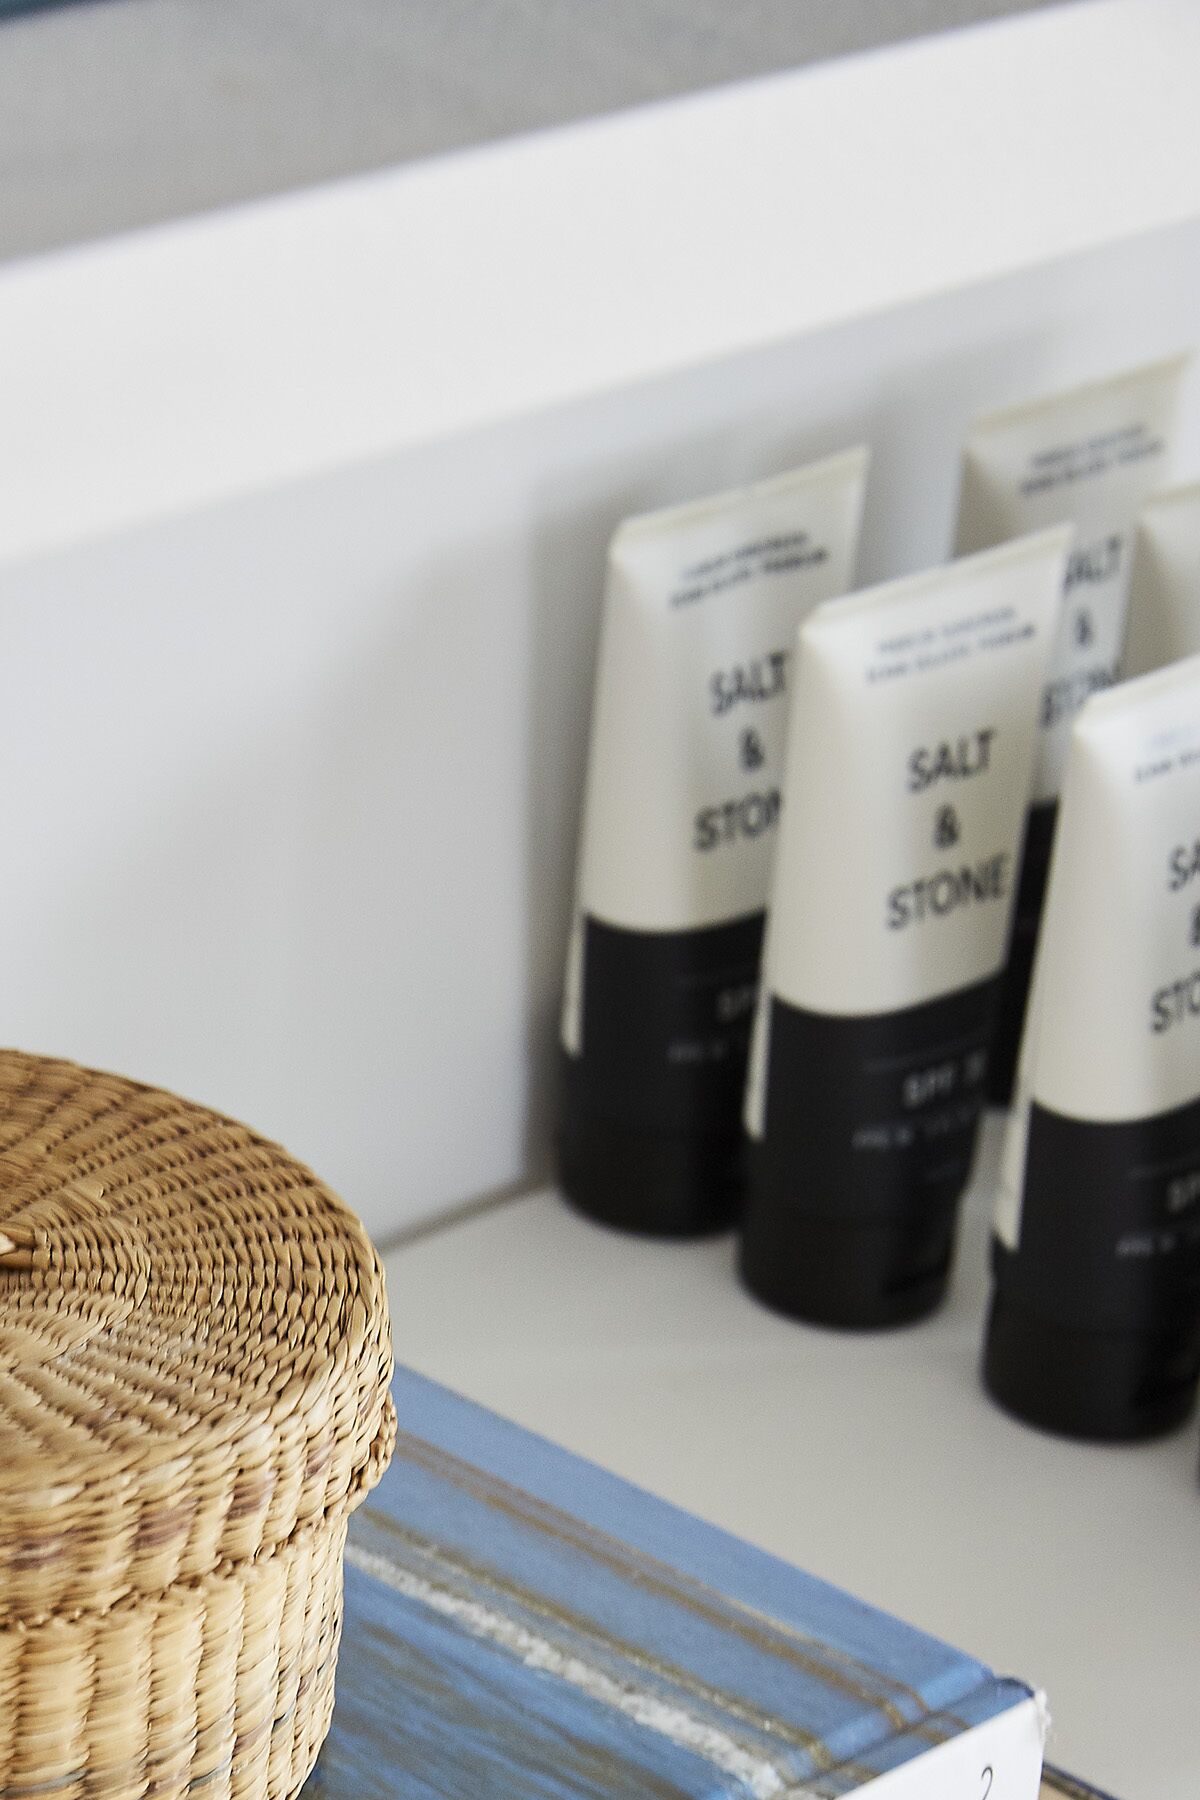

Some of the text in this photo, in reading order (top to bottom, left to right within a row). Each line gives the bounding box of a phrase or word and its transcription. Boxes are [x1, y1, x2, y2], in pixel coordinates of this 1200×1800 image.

[710, 650, 787, 717] SALT
[908, 727, 994, 792] SALT
[887, 853, 1007, 931] STONE
